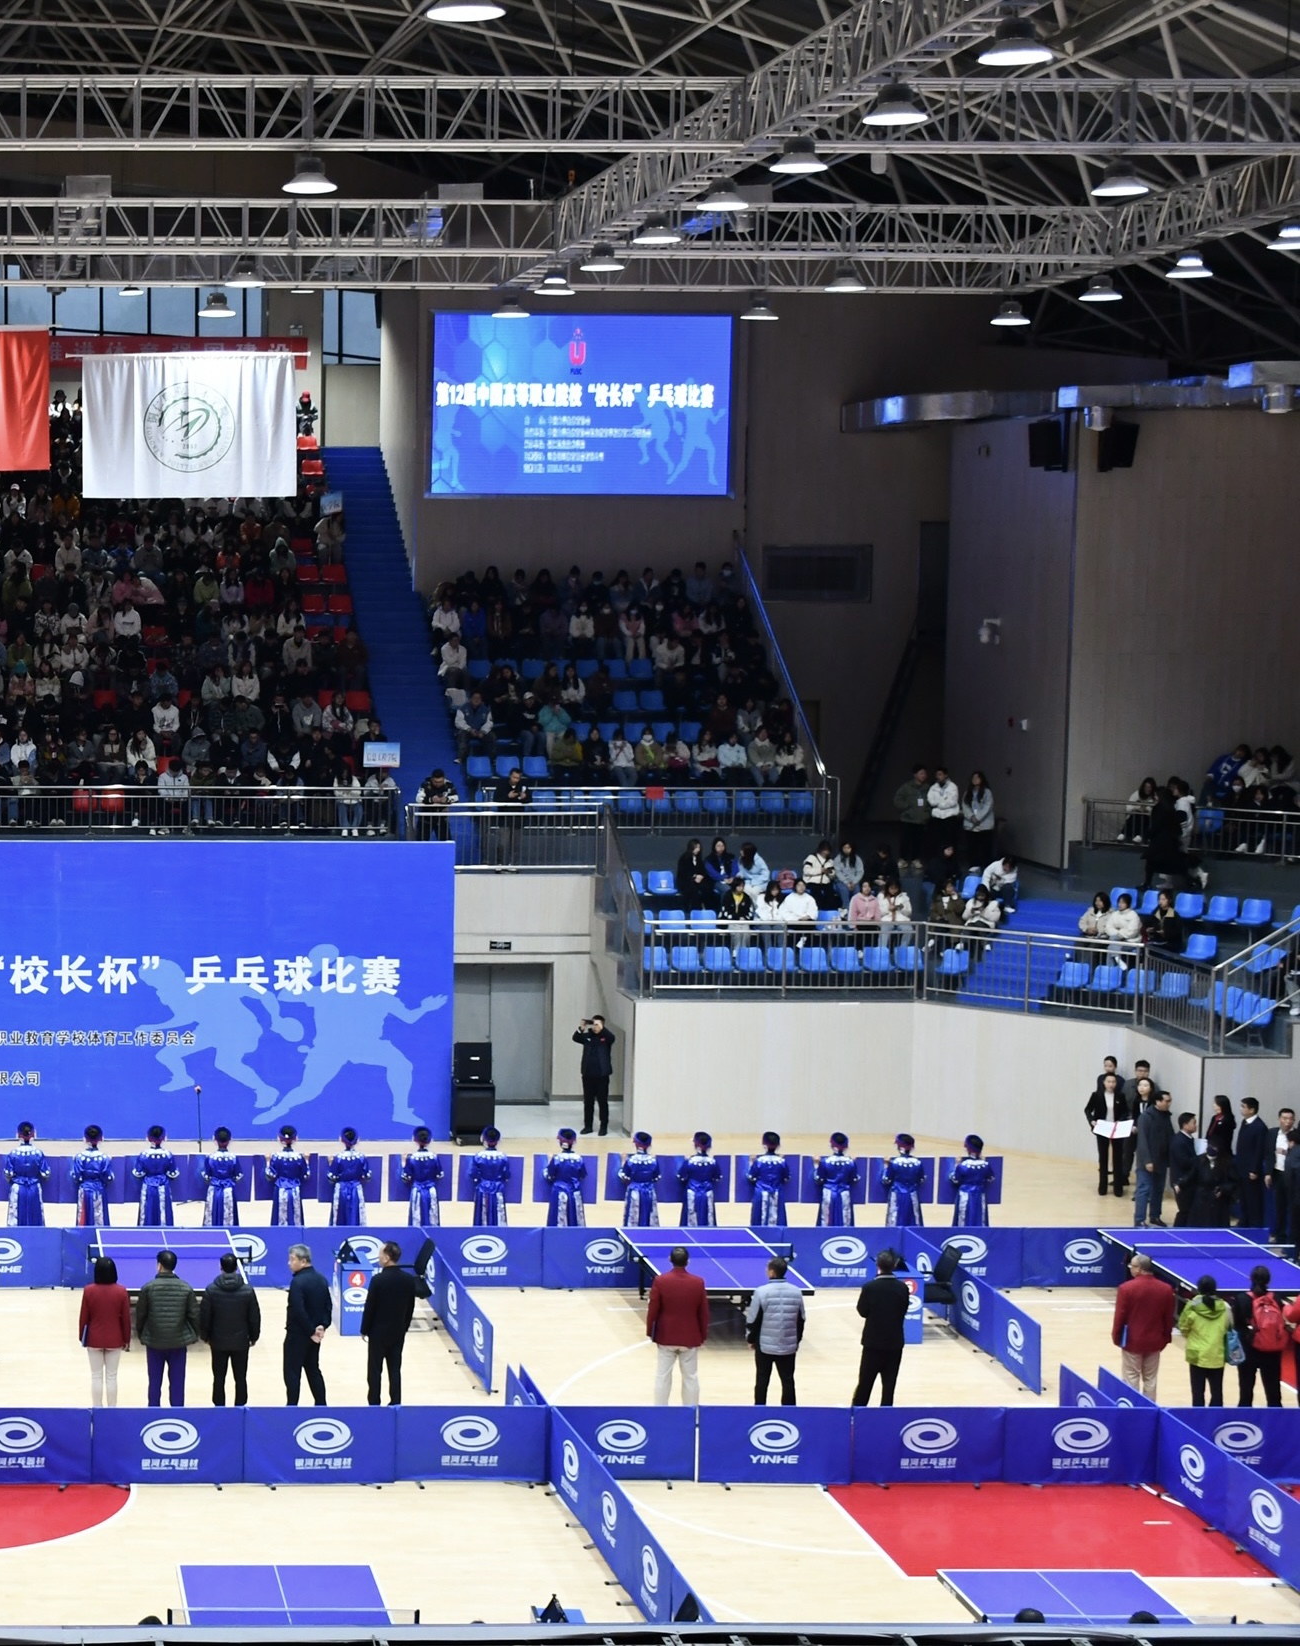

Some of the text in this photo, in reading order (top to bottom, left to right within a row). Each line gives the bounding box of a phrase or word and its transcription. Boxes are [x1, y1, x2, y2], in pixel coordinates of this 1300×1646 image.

[586, 1265, 624, 1274] YINHE
[1064, 1265, 1102, 1273] YINHE
[351, 1273, 362, 1285] 4
[597, 1455, 647, 1465] YINHE
[749, 1454, 800, 1464] YINHE
